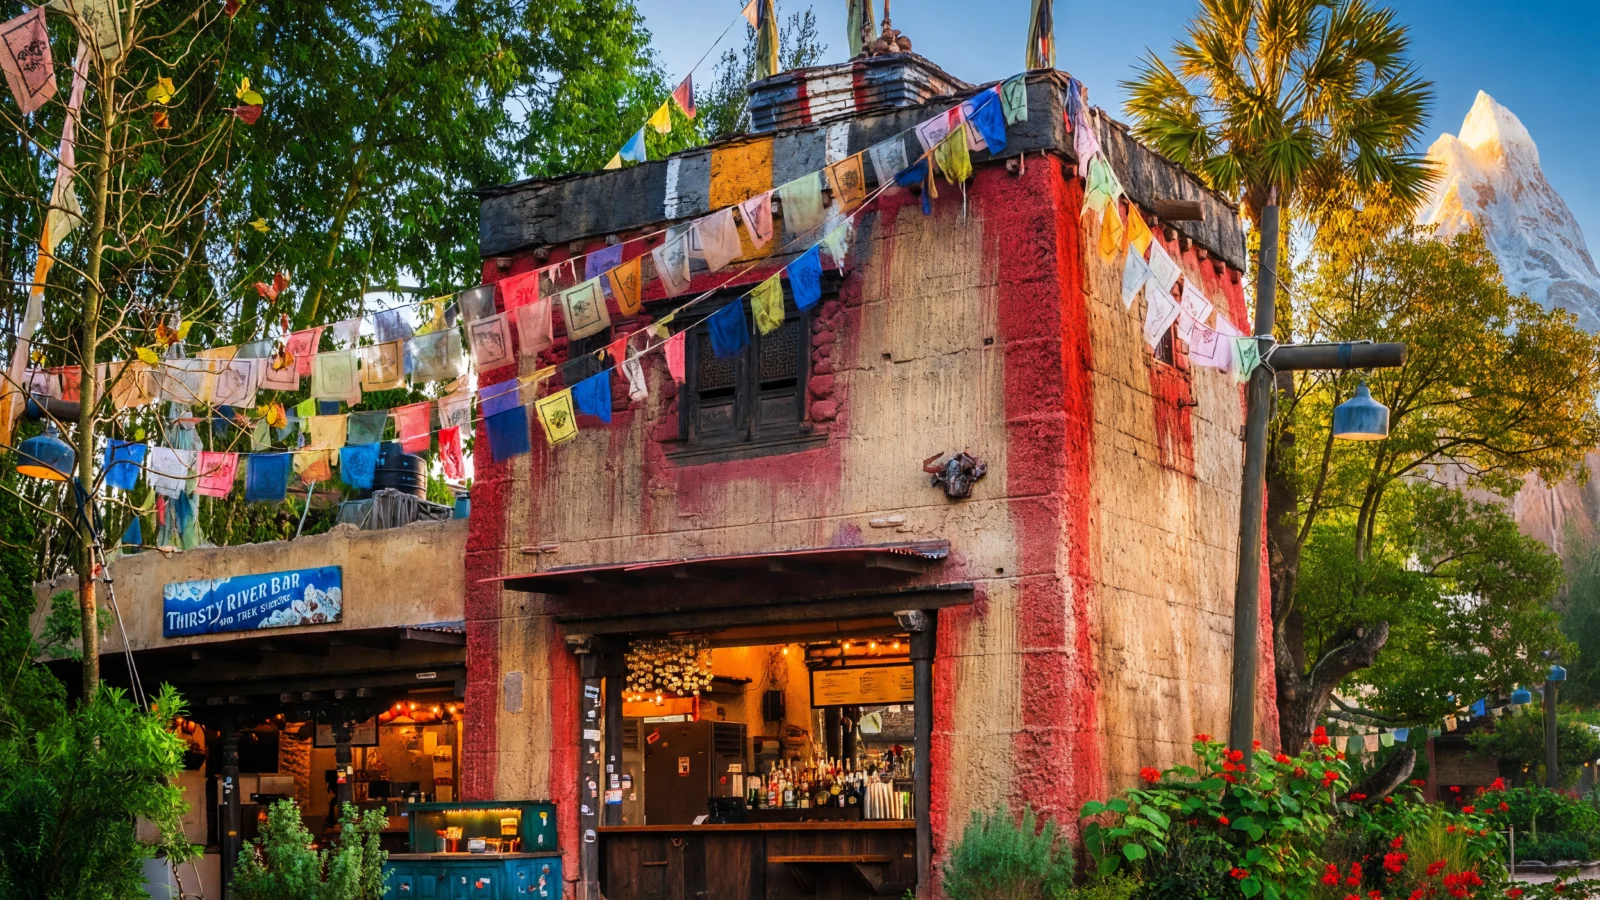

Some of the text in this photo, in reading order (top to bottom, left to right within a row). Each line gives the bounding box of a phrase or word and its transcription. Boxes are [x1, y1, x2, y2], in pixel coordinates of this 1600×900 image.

[167, 600, 224, 630] THIRSTY
[227, 582, 267, 612] RIVER
[271, 572, 300, 595] BAR
[237, 607, 258, 622] TREK
